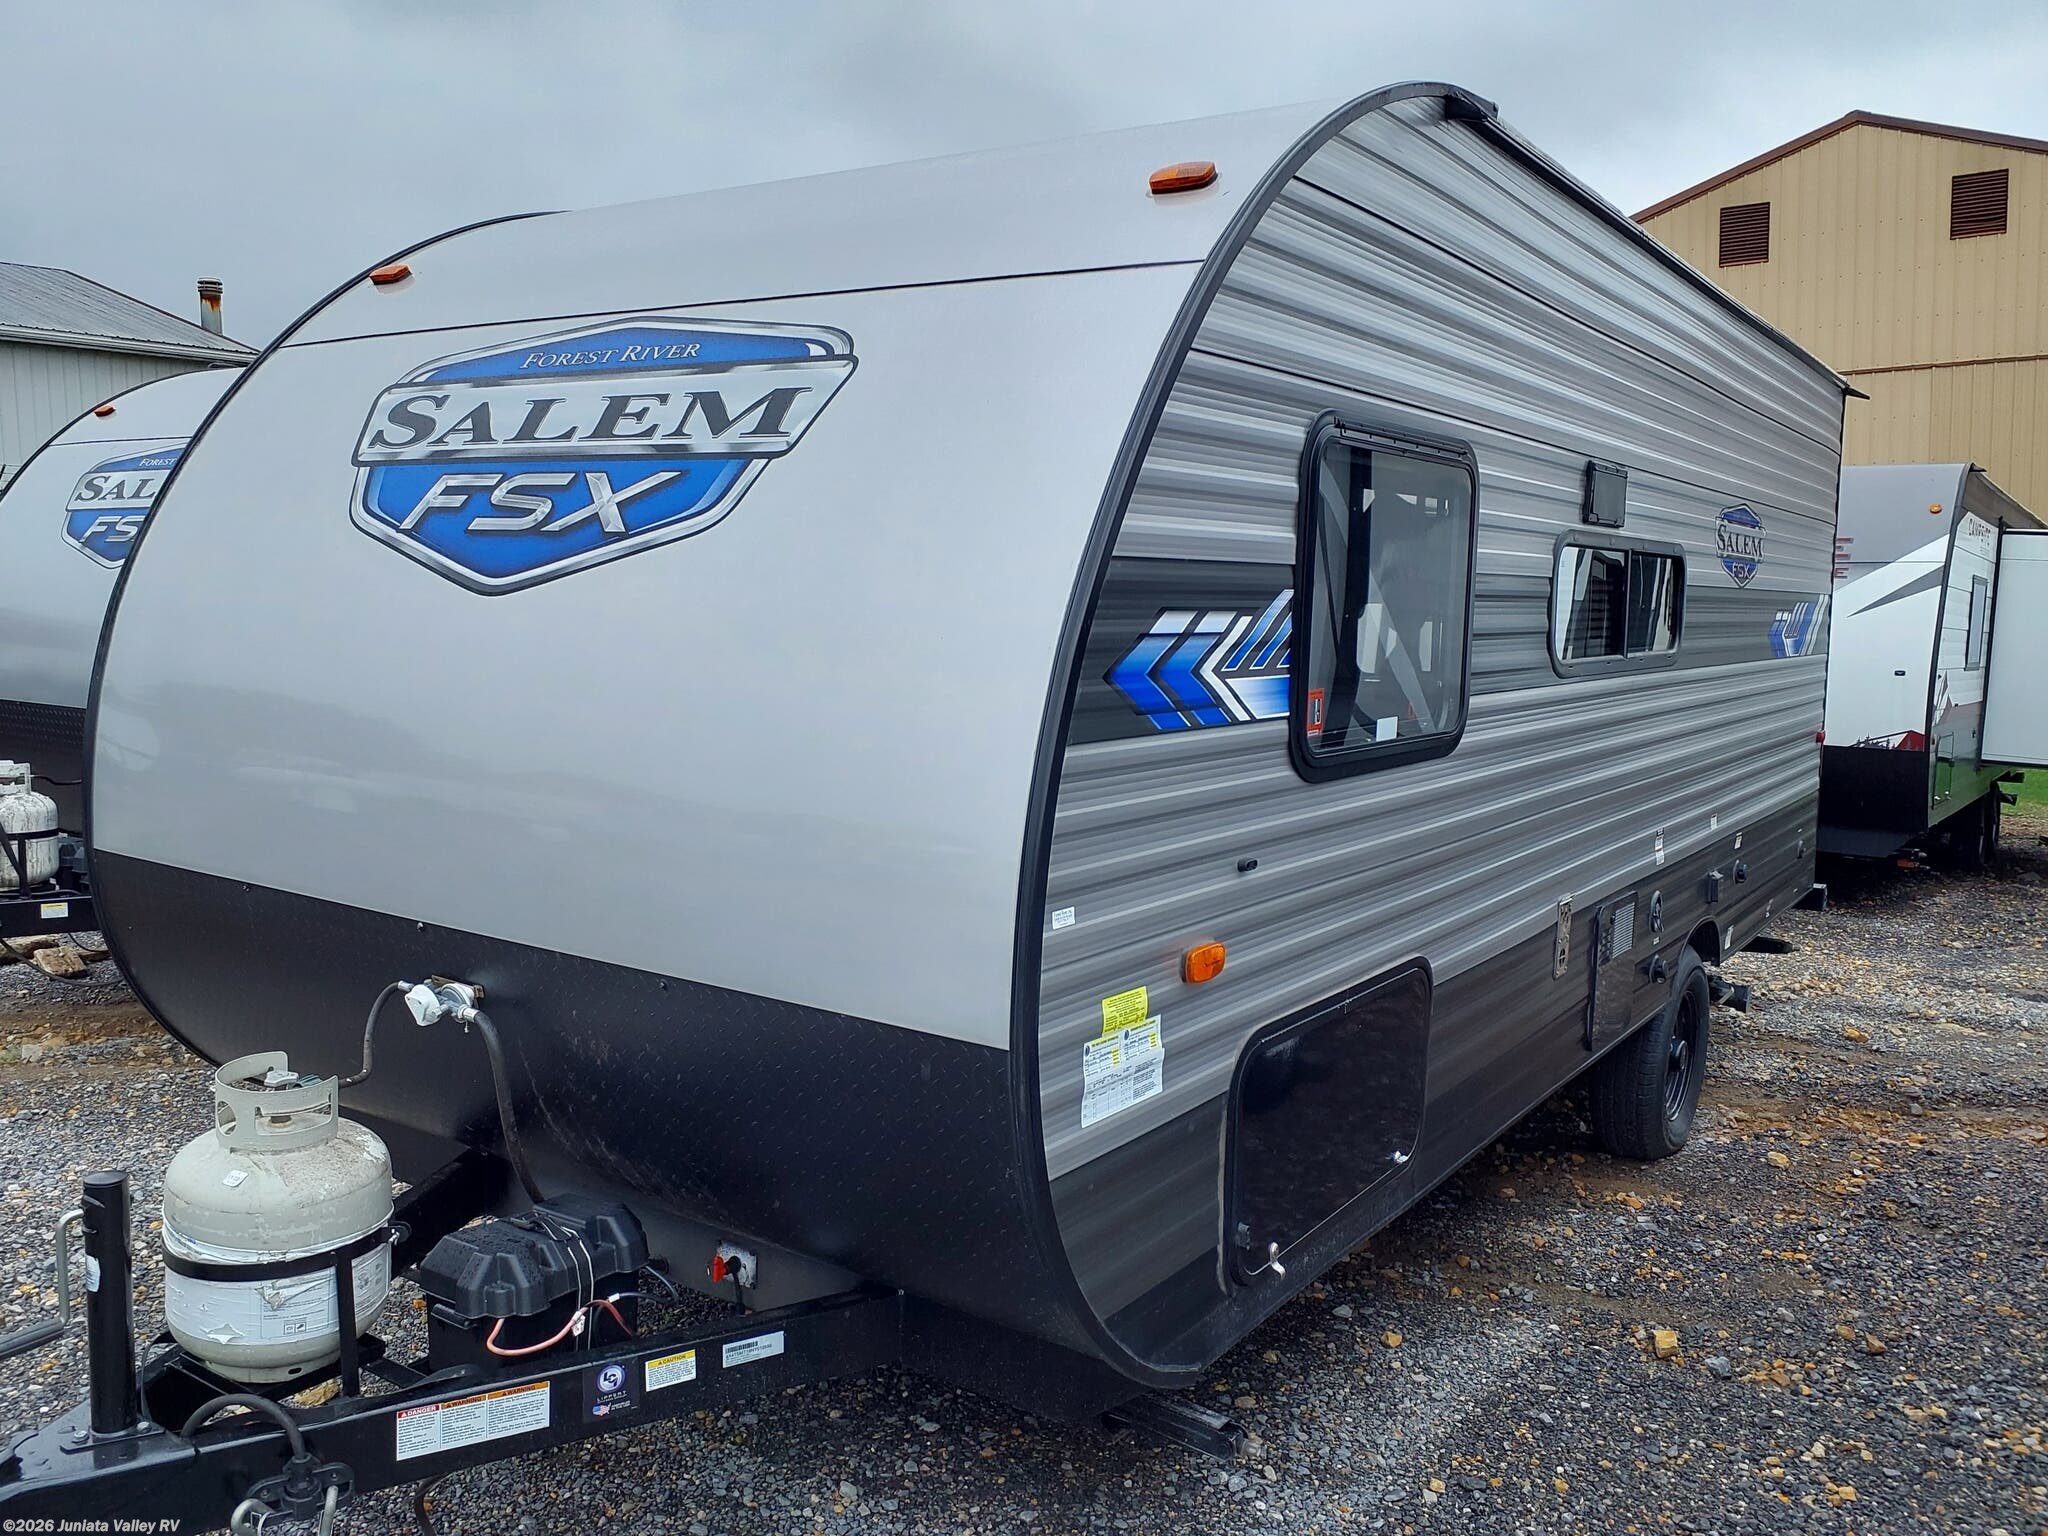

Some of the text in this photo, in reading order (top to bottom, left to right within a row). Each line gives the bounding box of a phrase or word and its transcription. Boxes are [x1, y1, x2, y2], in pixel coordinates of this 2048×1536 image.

[519, 342, 700, 369] FOREST RIVER
[366, 386, 813, 450] SALEM
[398, 471, 682, 534] FSX
[1717, 524, 1763, 559] SALEM
[1732, 562, 1750, 578] FSX
[407, 1405, 437, 1417] DANGER
